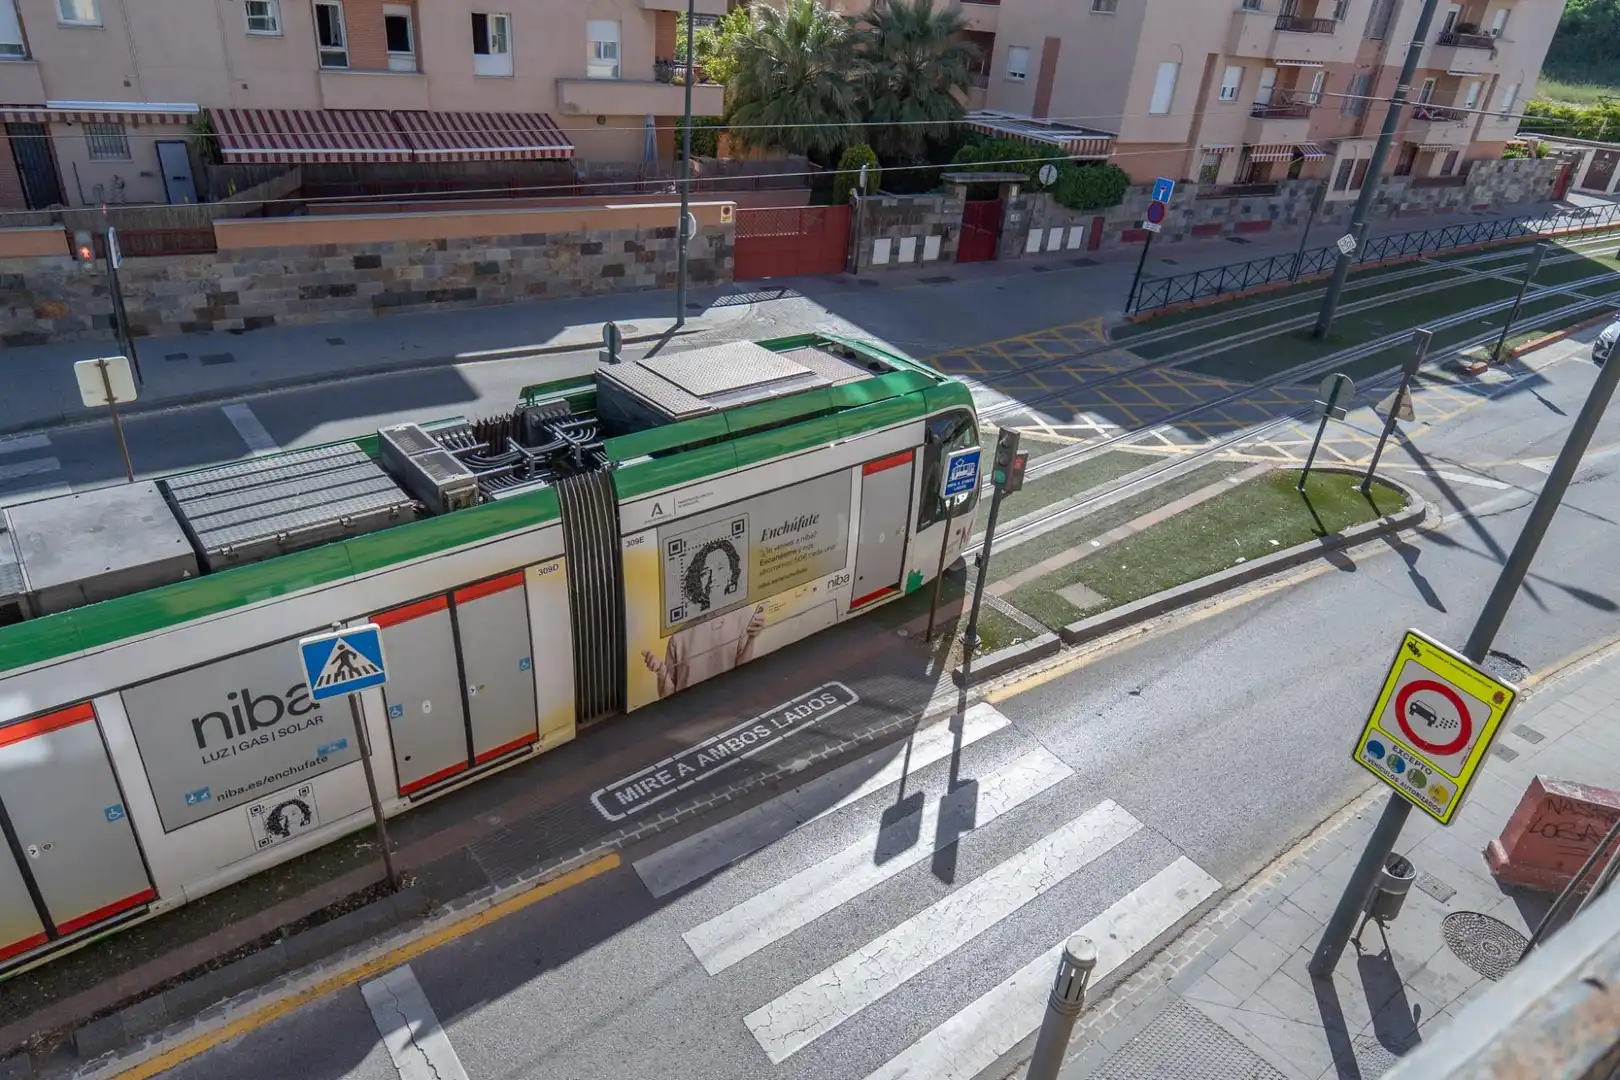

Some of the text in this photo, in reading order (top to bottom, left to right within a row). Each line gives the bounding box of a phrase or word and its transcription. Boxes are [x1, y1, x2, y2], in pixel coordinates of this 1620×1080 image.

[625, 536, 645, 548] 309E
[760, 513, 820, 543] Enchúfate
[537, 563, 560, 576] 309D
[826, 573, 851, 590] niba
[191, 682, 321, 749] niba
[201, 715, 324, 765] LUZ GAS SOLAR
[615, 691, 838, 806] MIRE A AMBOS LADOS
[1392, 744, 1433, 776] EXCEPTO
[216, 755, 329, 803] niba.es/enchufate
[1399, 780, 1442, 815] AUTORIZADOS
